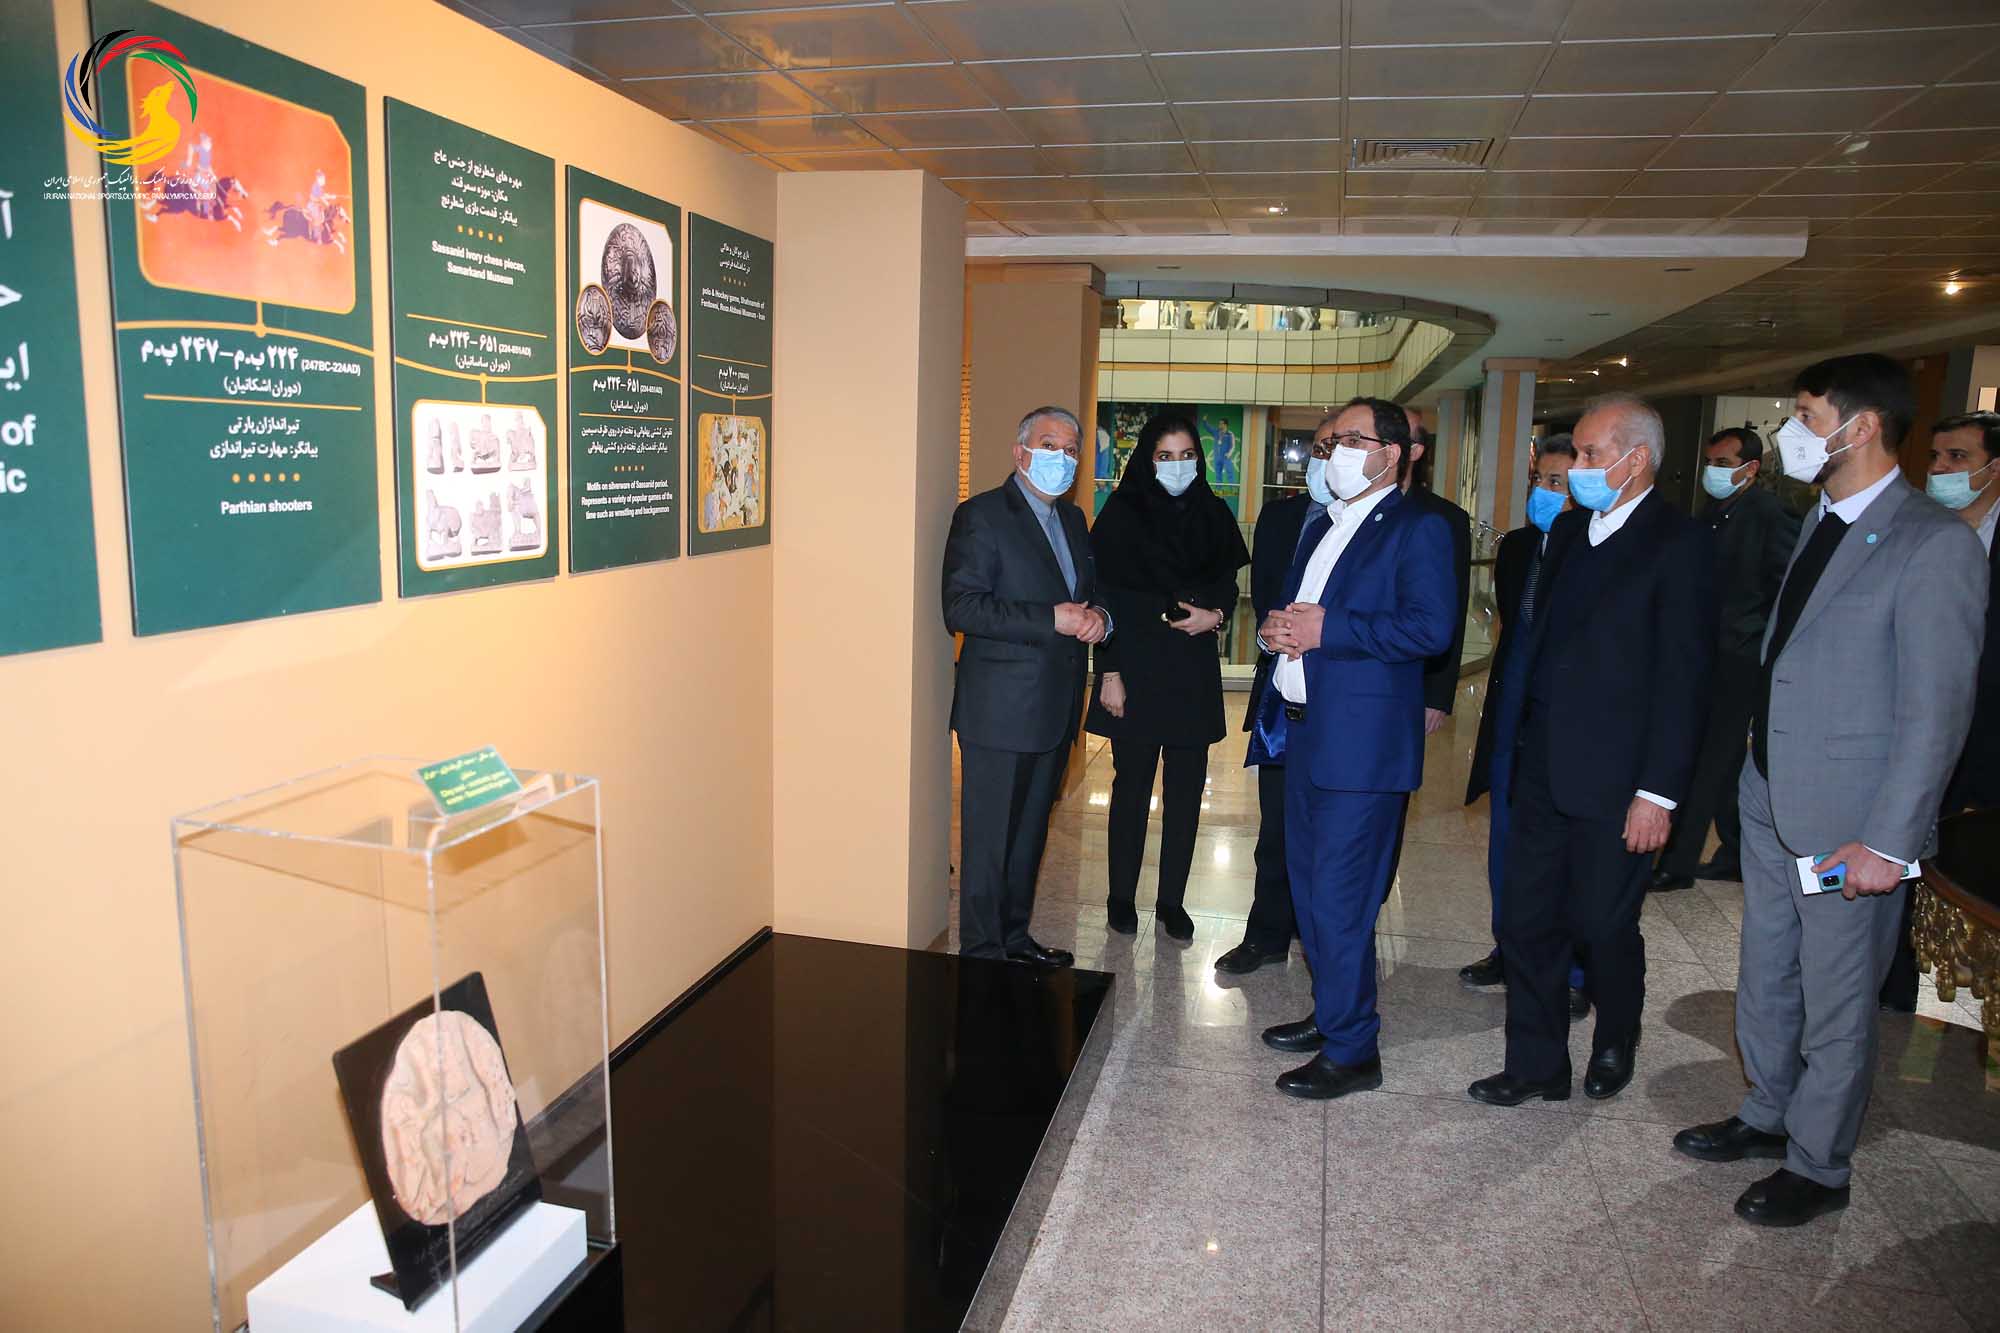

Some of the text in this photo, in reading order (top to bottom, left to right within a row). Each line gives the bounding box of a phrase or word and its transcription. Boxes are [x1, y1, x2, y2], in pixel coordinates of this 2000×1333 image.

[432, 240, 465, 258] Sassanid
[483, 253, 503, 267] chess
[486, 269, 514, 286] Museum
[301, 359, 361, 377] (247BC-224AD)
[1, 414, 37, 446] of
[221, 500, 313, 515] Parthian shooters
[586, 511, 596, 520] time
[597, 509, 608, 518] such
